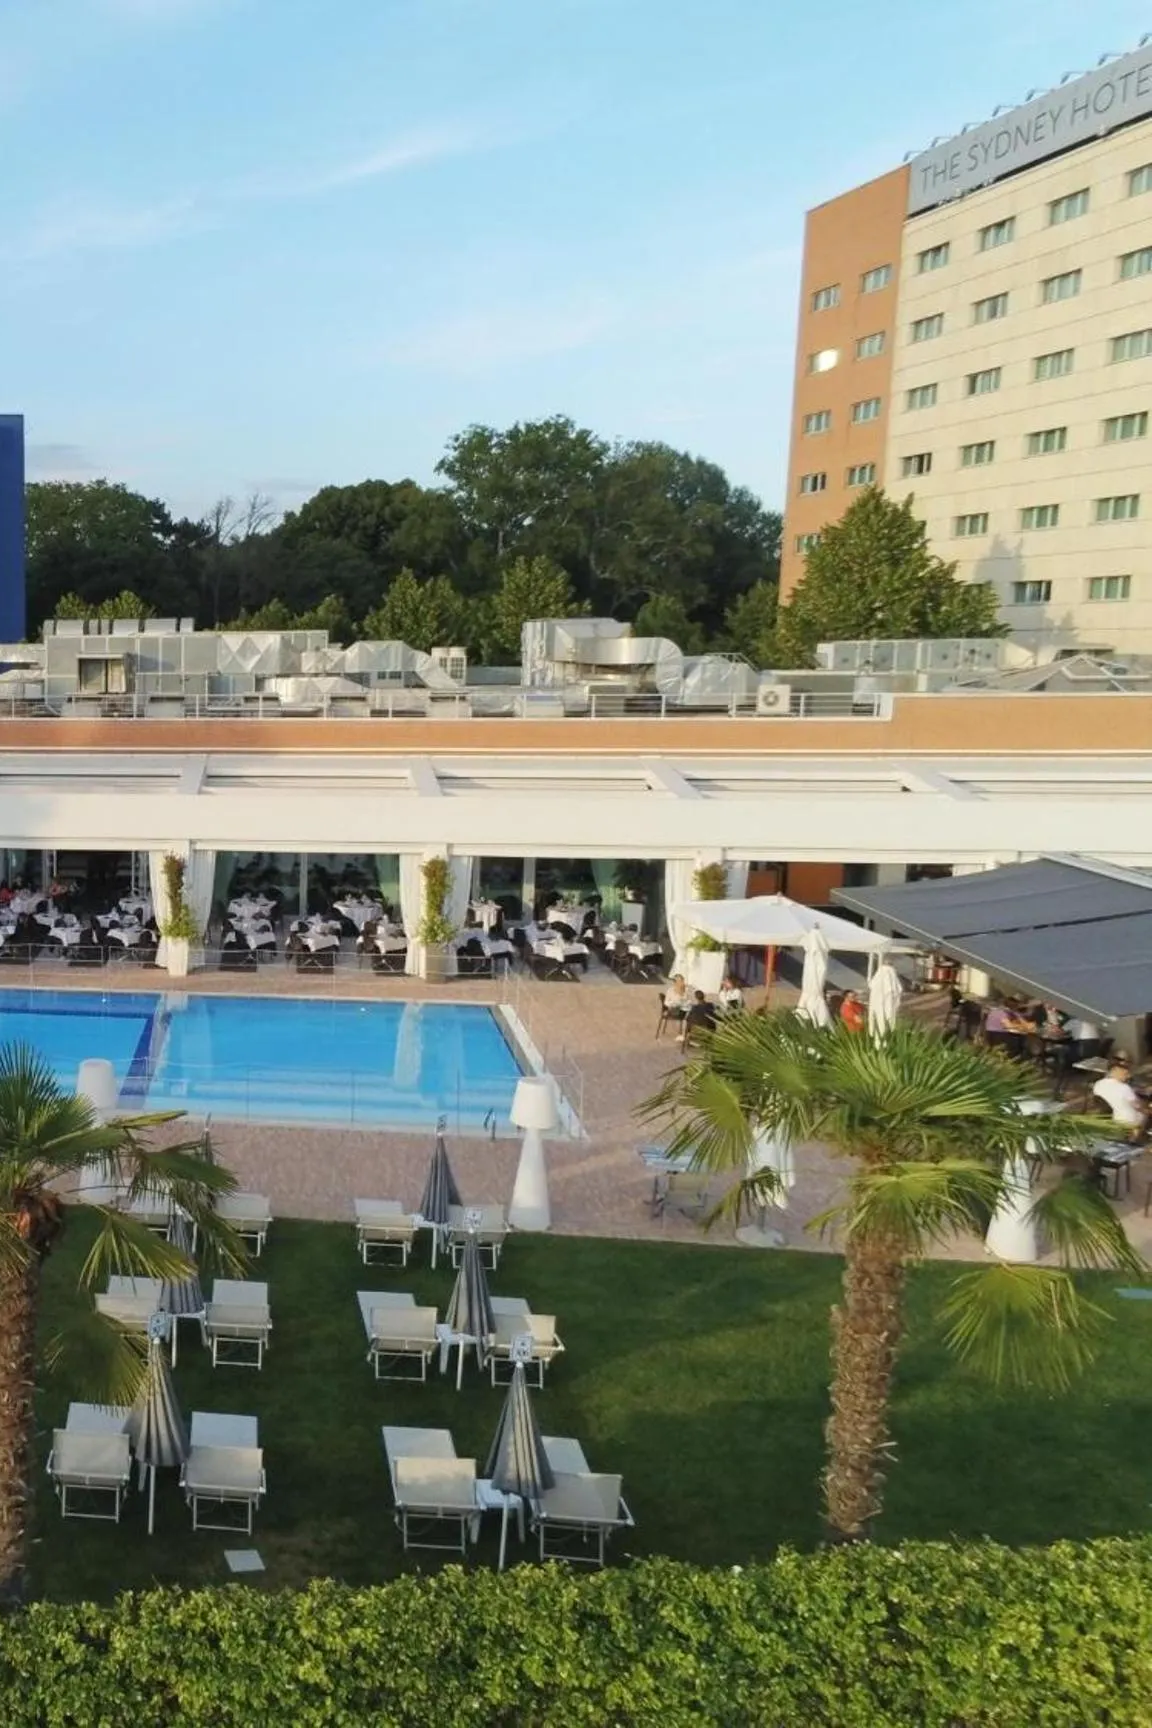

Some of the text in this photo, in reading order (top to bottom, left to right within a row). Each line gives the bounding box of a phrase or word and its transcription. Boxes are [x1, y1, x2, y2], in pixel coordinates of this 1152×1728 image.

[921, 62, 1152, 193] THE SYDNEY HOTE
